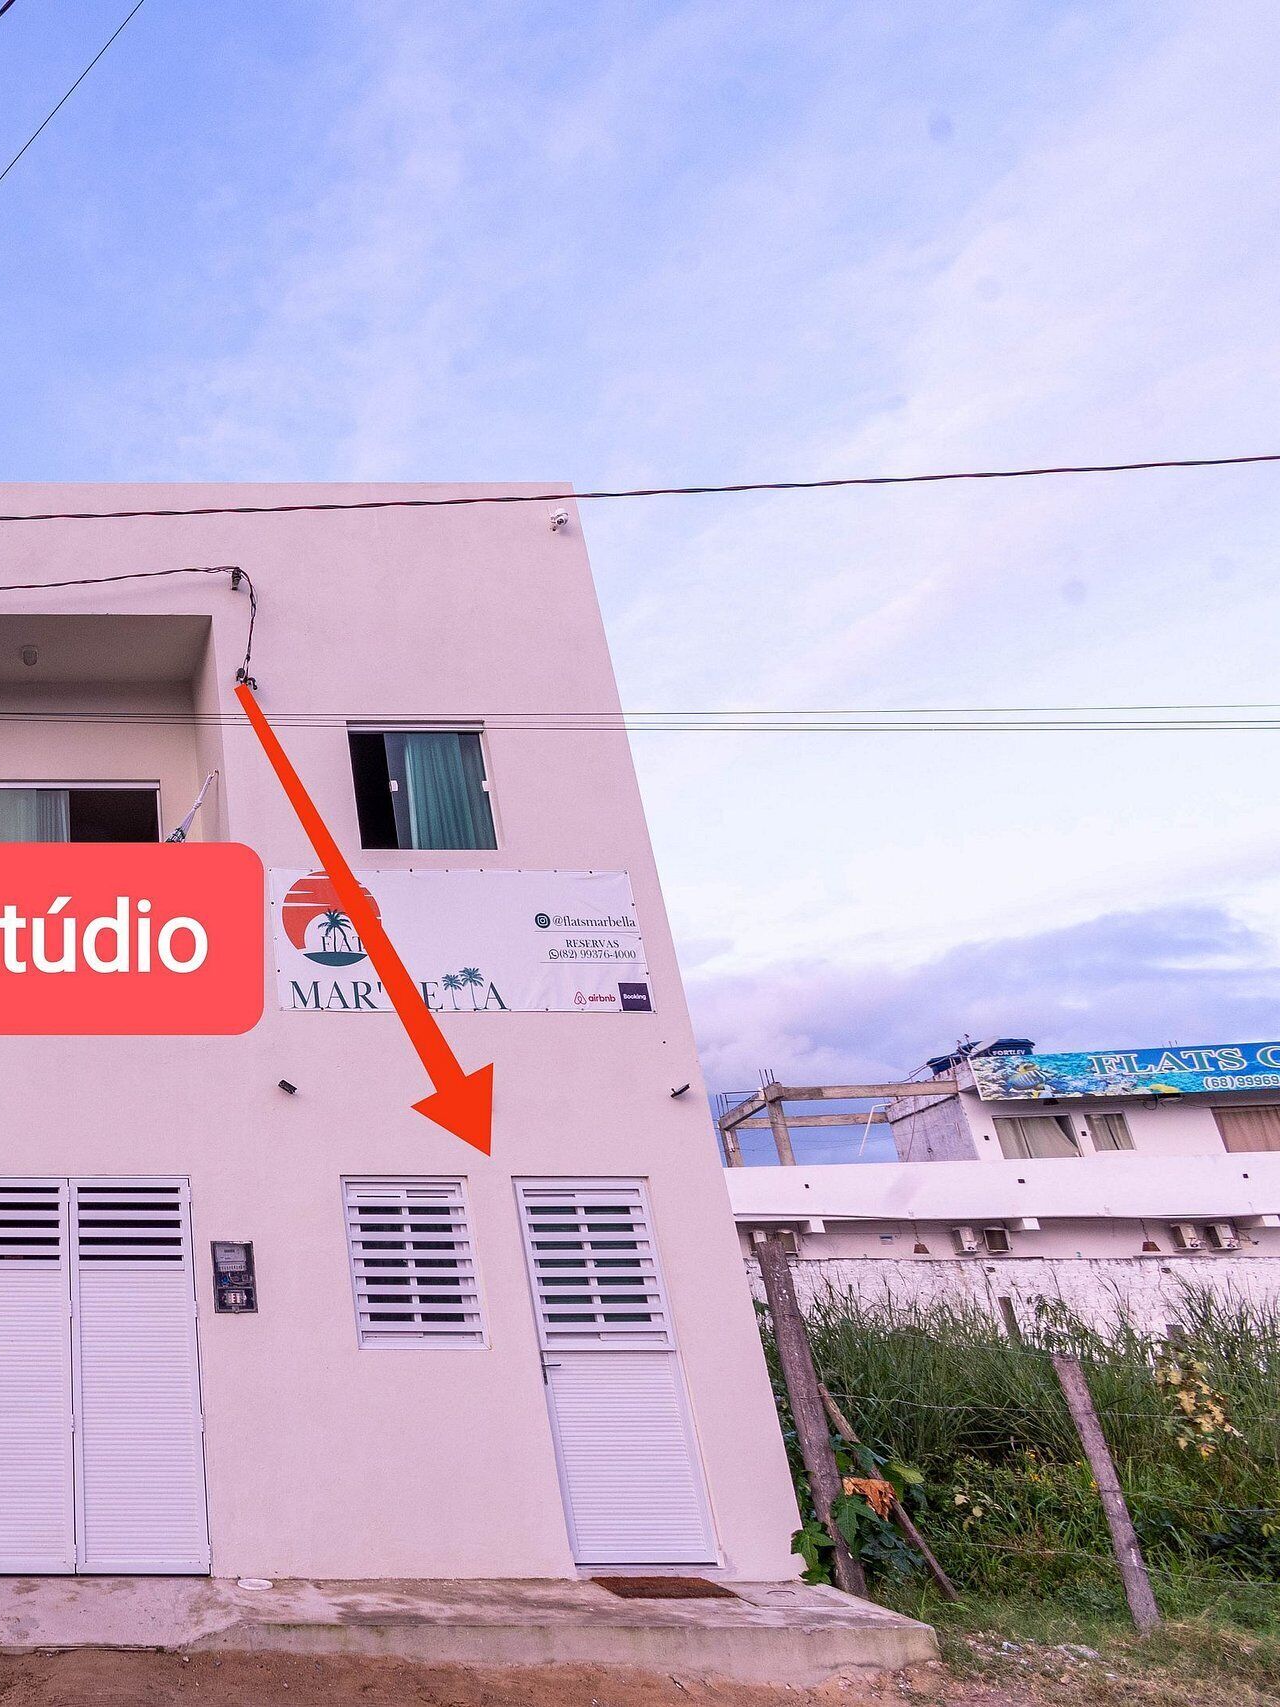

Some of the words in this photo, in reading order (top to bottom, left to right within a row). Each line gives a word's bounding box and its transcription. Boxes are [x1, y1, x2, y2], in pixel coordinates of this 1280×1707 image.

[552, 915, 636, 928] @flatsmarbella
[565, 939, 620, 948] RESERVAS
[559, 948, 578, 960] (82)
[580, 949, 636, 960] 99376-4000
[289, 980, 382, 1010] MAR'
[587, 993, 617, 1003] airbnb
[622, 993, 647, 1001] Booking
[1089, 1048, 1248, 1077] FLATS
